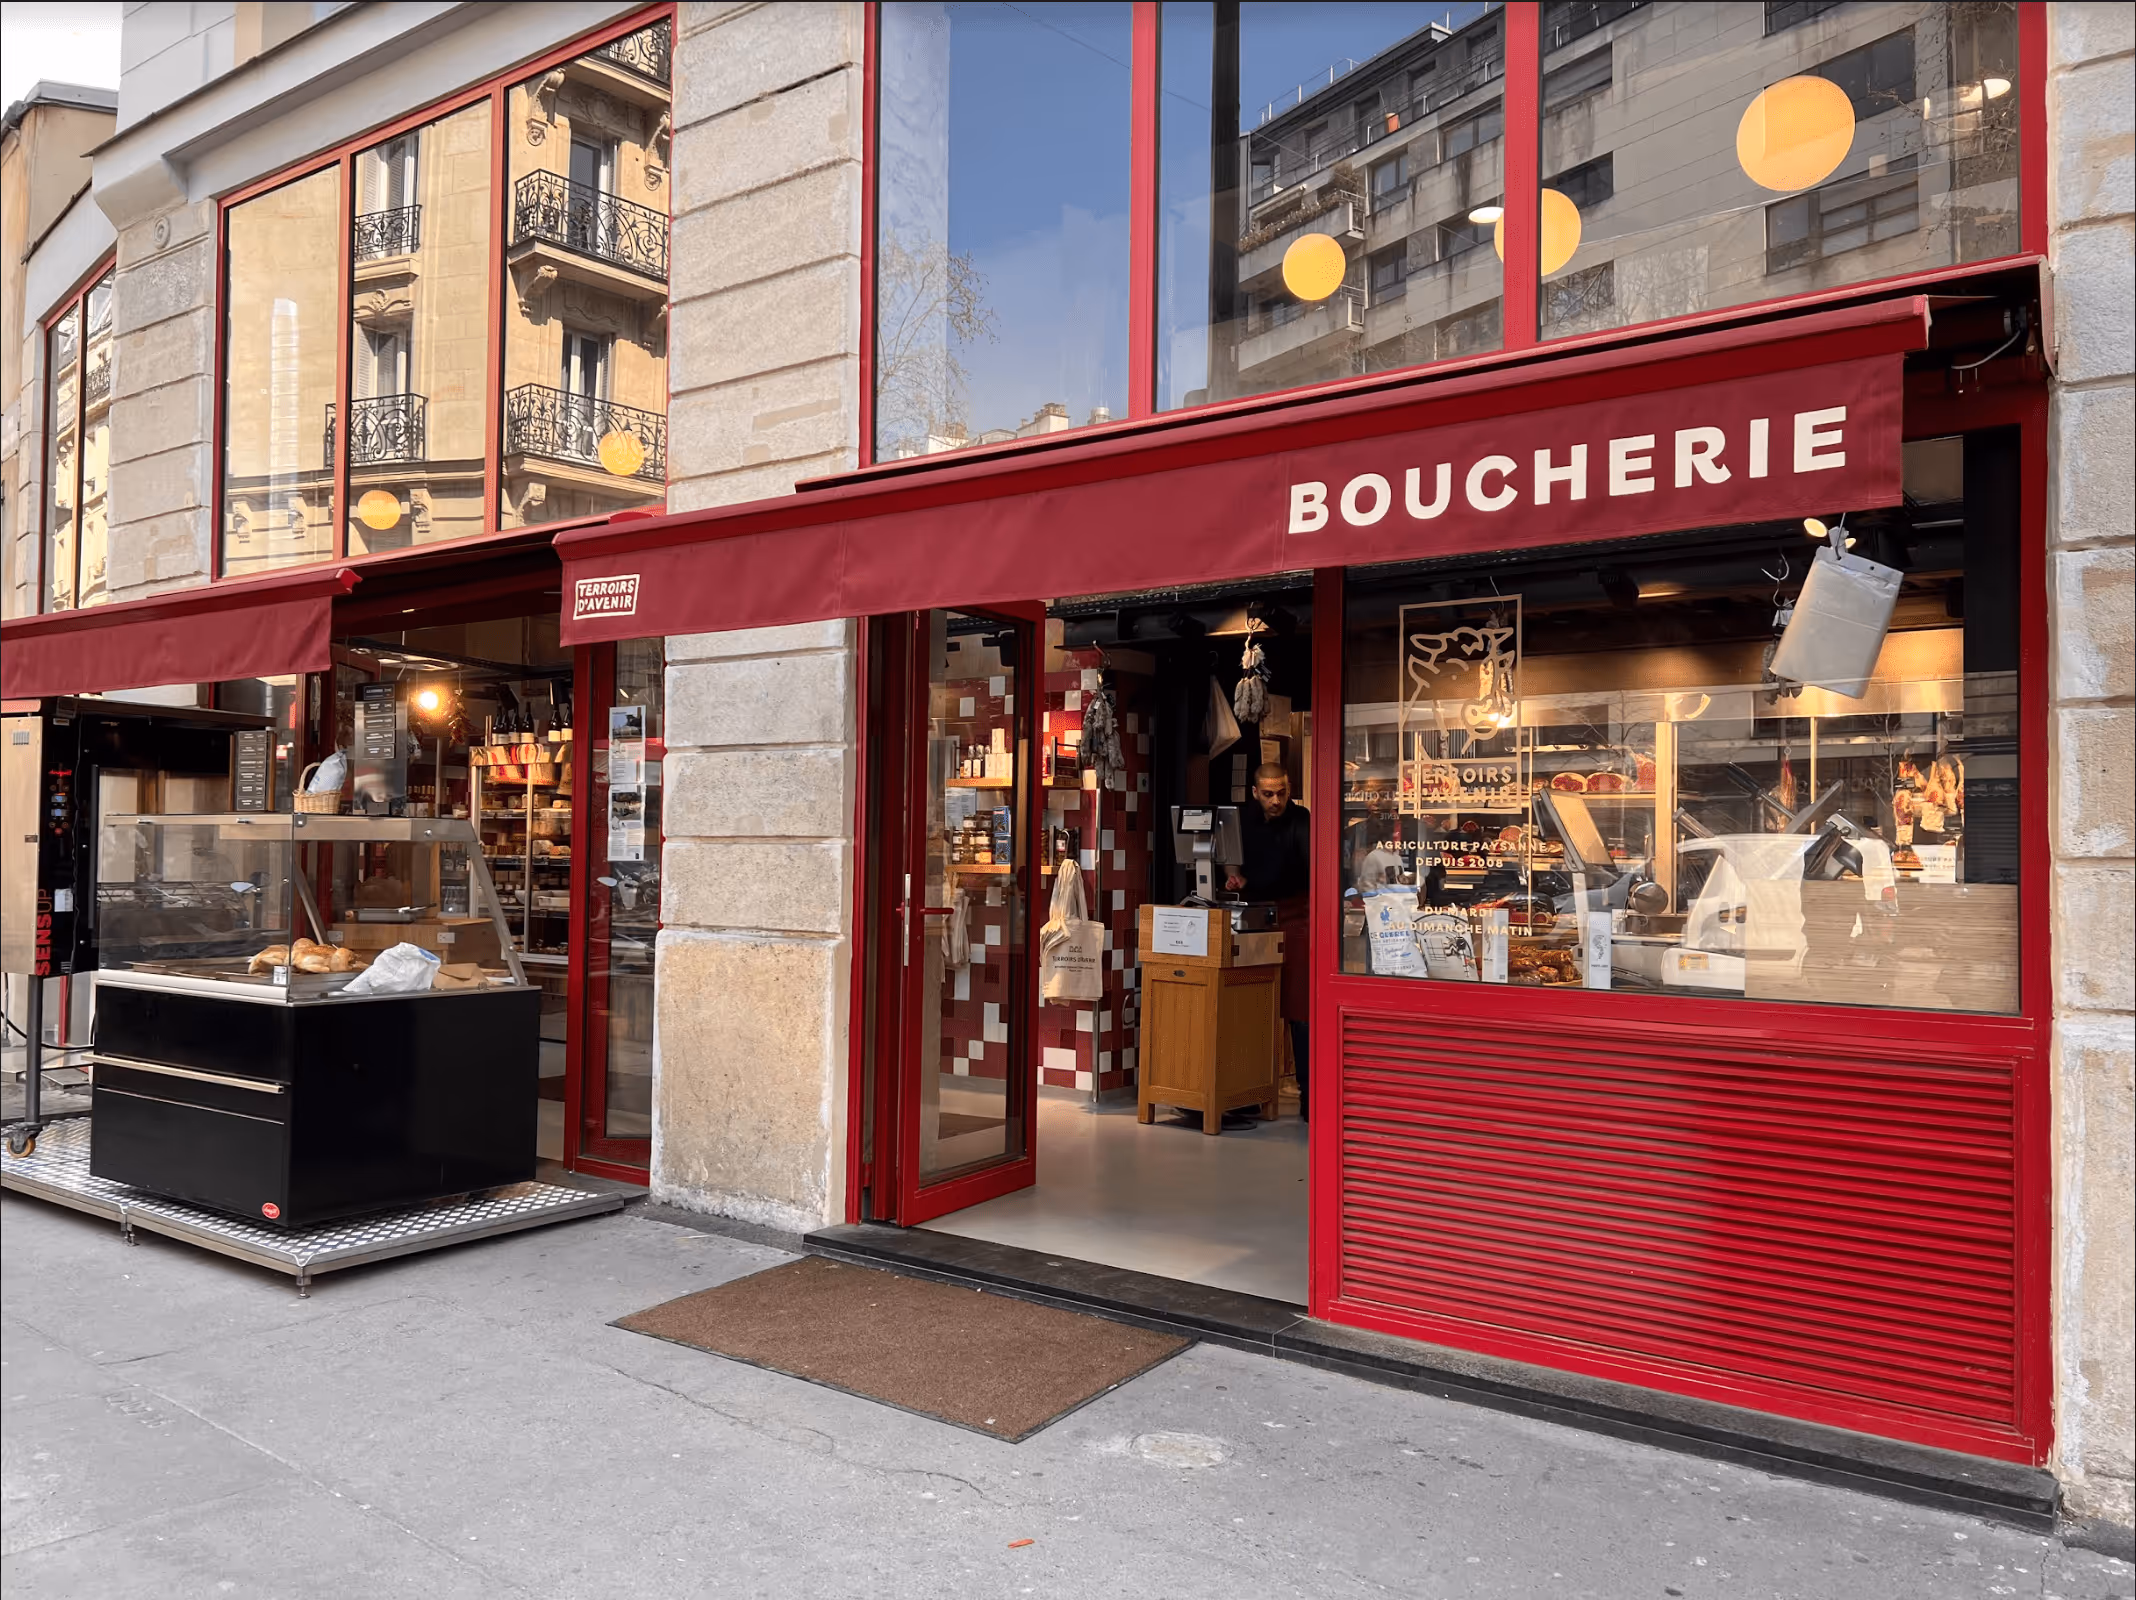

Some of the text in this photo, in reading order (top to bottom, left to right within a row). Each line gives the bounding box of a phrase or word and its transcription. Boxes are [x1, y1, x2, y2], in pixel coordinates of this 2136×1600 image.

[1288, 406, 1847, 535] BOUCHERIE
[579, 580, 634, 597] TERROIRS
[578, 595, 633, 612] D'AVENIR
[1407, 766, 1512, 784] TERROIRS
[1407, 786, 1513, 804] D'AVENIR
[1376, 840, 1547, 854] AGRICULTURE PAYSANNE
[1415, 857, 1504, 868] DEPUIS 2008
[1424, 906, 1494, 918] DU MARDI
[1388, 921, 1533, 937] AU DIMANCHE MATIN
